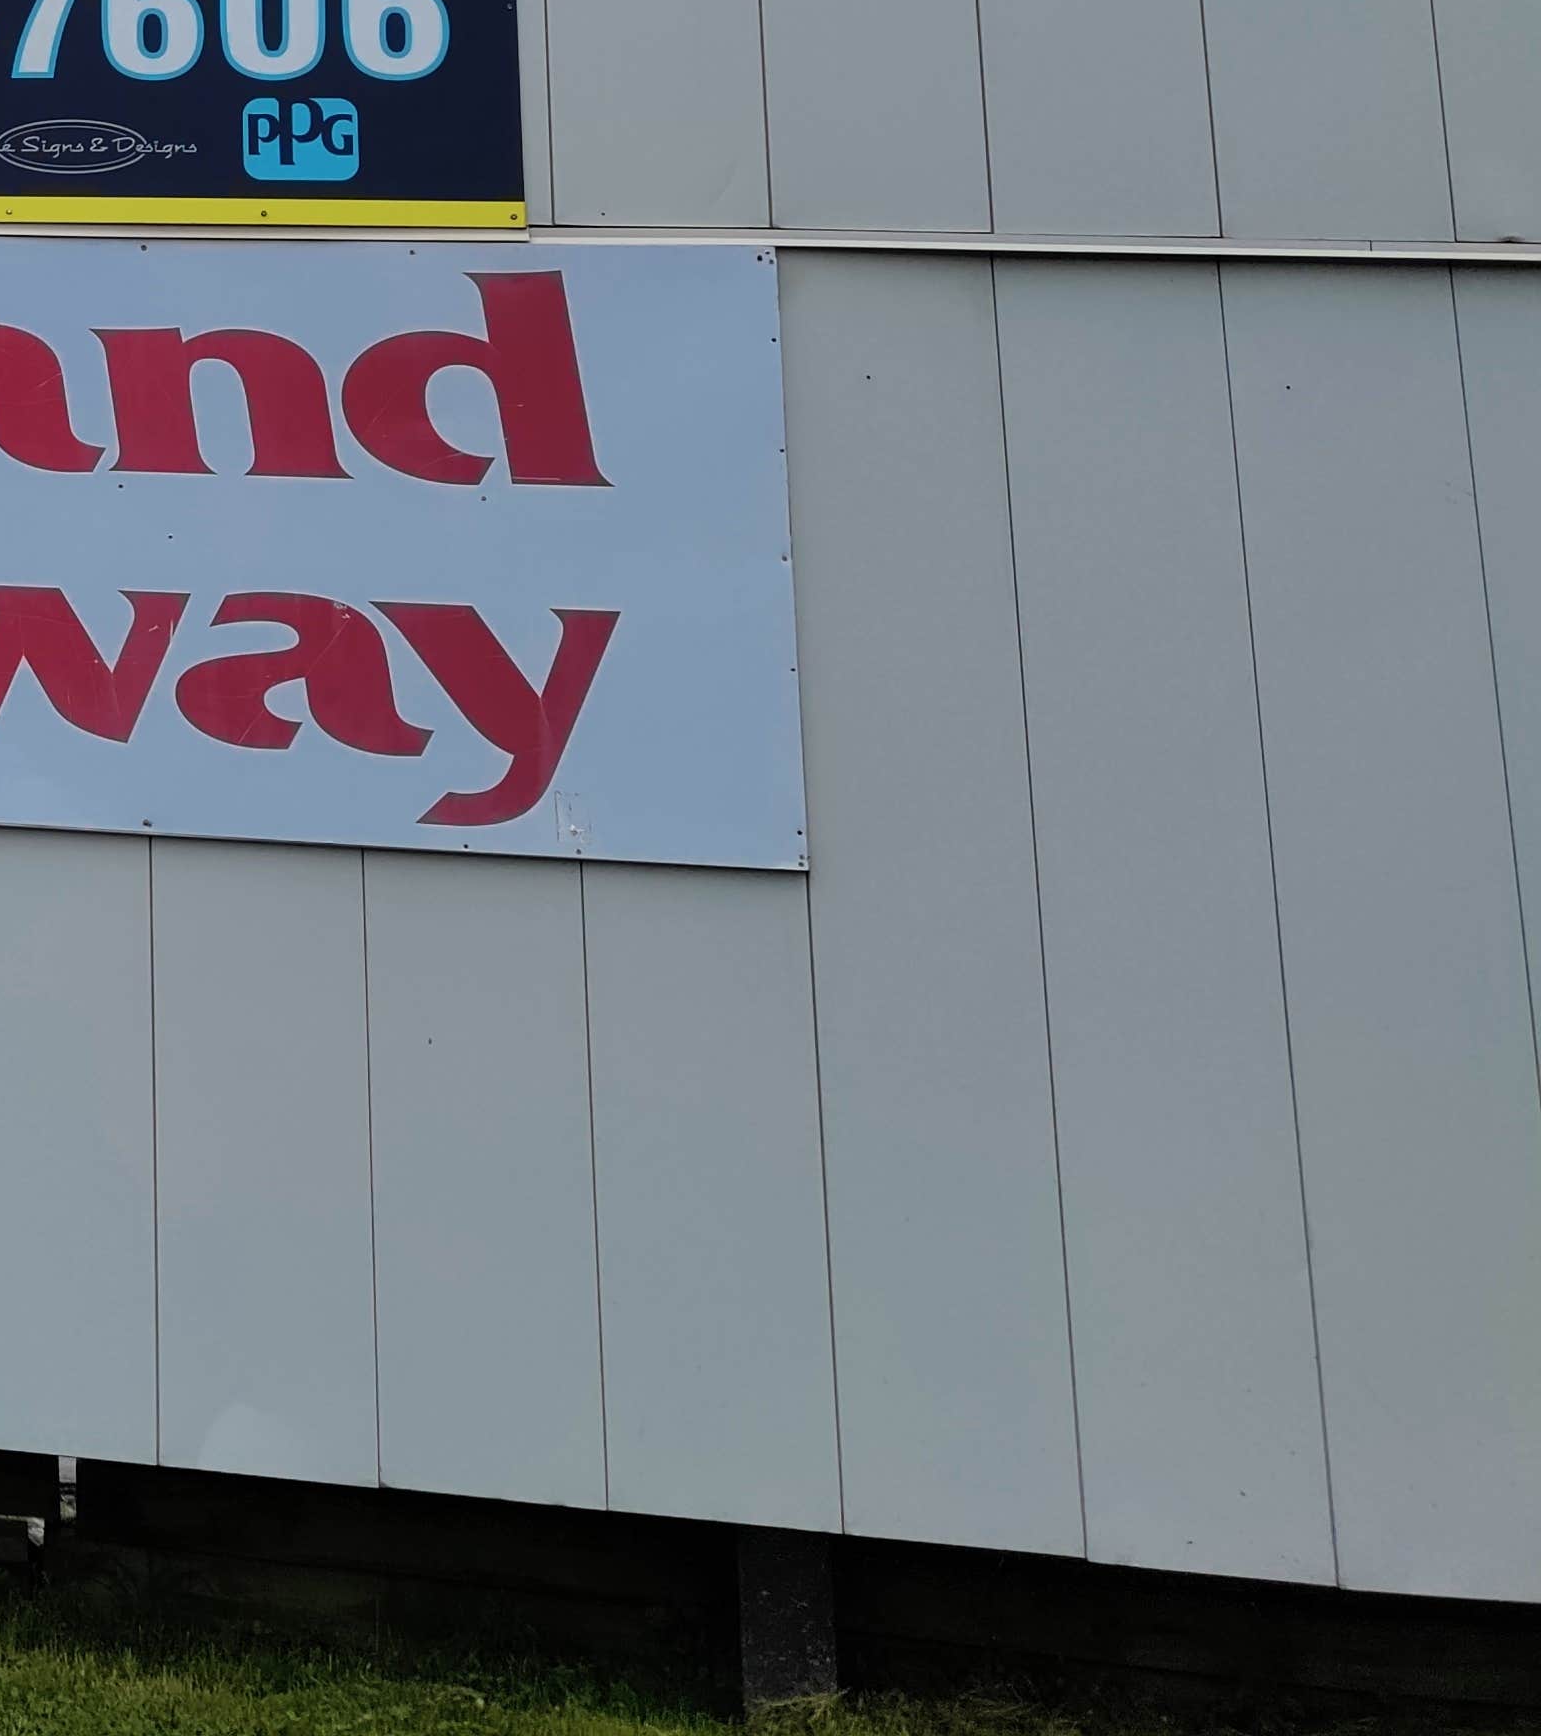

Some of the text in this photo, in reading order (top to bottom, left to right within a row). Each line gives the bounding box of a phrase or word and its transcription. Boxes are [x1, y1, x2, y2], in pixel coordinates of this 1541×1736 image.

[20, 135, 85, 158] Signs
[89, 137, 109, 152] &
[116, 137, 198, 159] Designs
[248, 96, 354, 166] PPG
